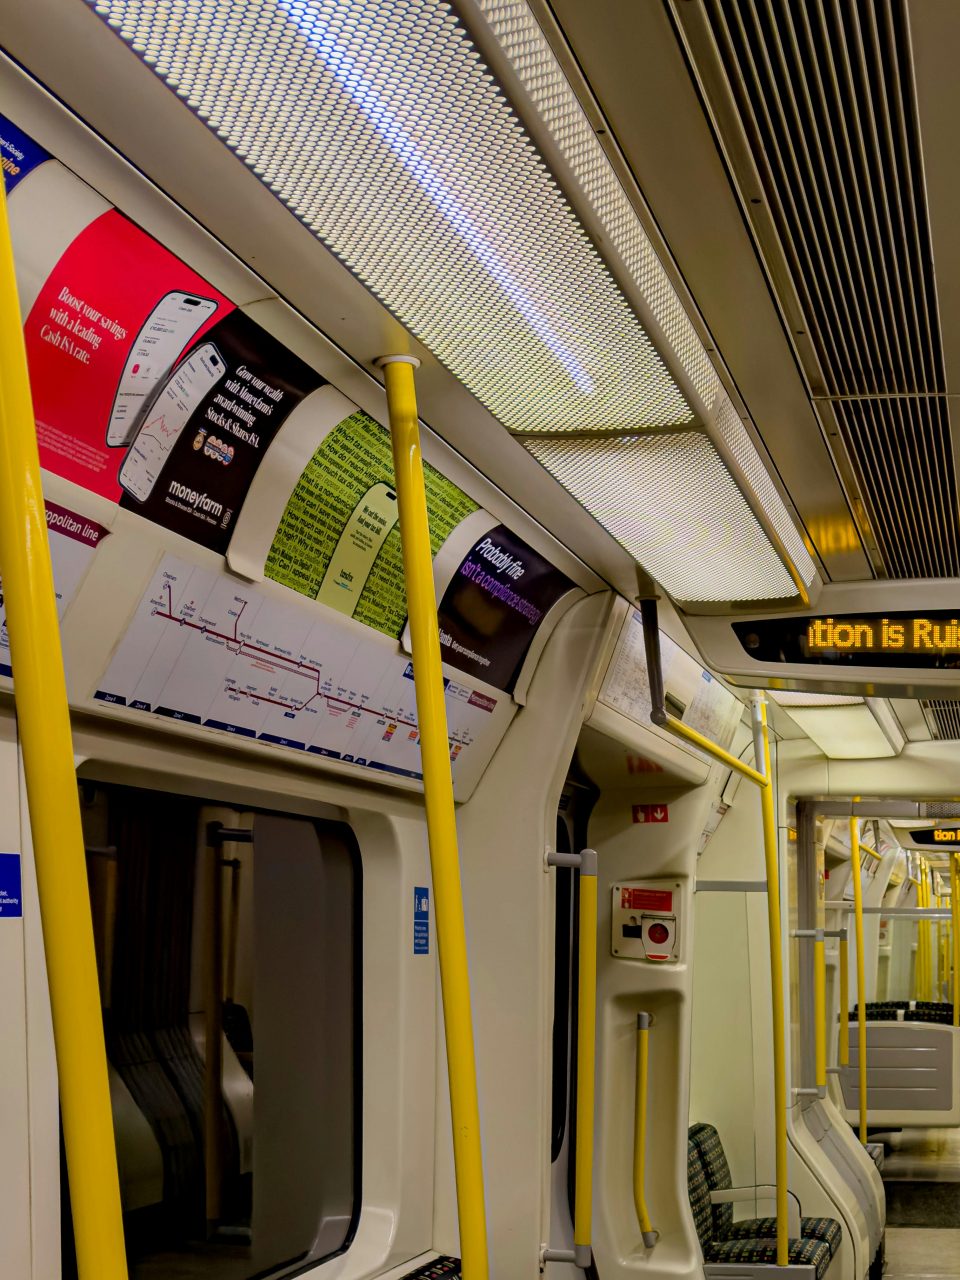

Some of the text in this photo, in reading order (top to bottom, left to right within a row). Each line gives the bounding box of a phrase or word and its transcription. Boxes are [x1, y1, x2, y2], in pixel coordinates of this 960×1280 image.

[7, 143, 25, 161] Society
[49, 307, 102, 350] with a leading
[58, 286, 84, 312] Boost
[79, 303, 102, 323] your
[99, 316, 128, 341] savings
[40, 324, 60, 347] Cash
[73, 347, 90, 365] rate.
[205, 407, 227, 427] Stocks
[224, 418, 233, 431] &
[213, 394, 257, 428] award-winning
[324, 442, 339, 456] How
[337, 451, 348, 462] do
[347, 458, 365, 474] reach
[334, 425, 355, 443] Which
[352, 439, 363, 450] tax
[361, 446, 384, 466] records
[321, 463, 339, 479] much
[336, 474, 347, 484] tax
[344, 479, 355, 490] do
[169, 480, 223, 517] moneyfarm
[82, 524, 99, 543] line
[298, 516, 315, 531] much
[313, 525, 325, 537] can
[295, 536, 310, 551] Why
[476, 538, 525, 580] Probably fine
[460, 556, 543, 625] isn't a compliance strategy
[882, 618, 905, 648] is
[934, 829, 955, 841] tion
